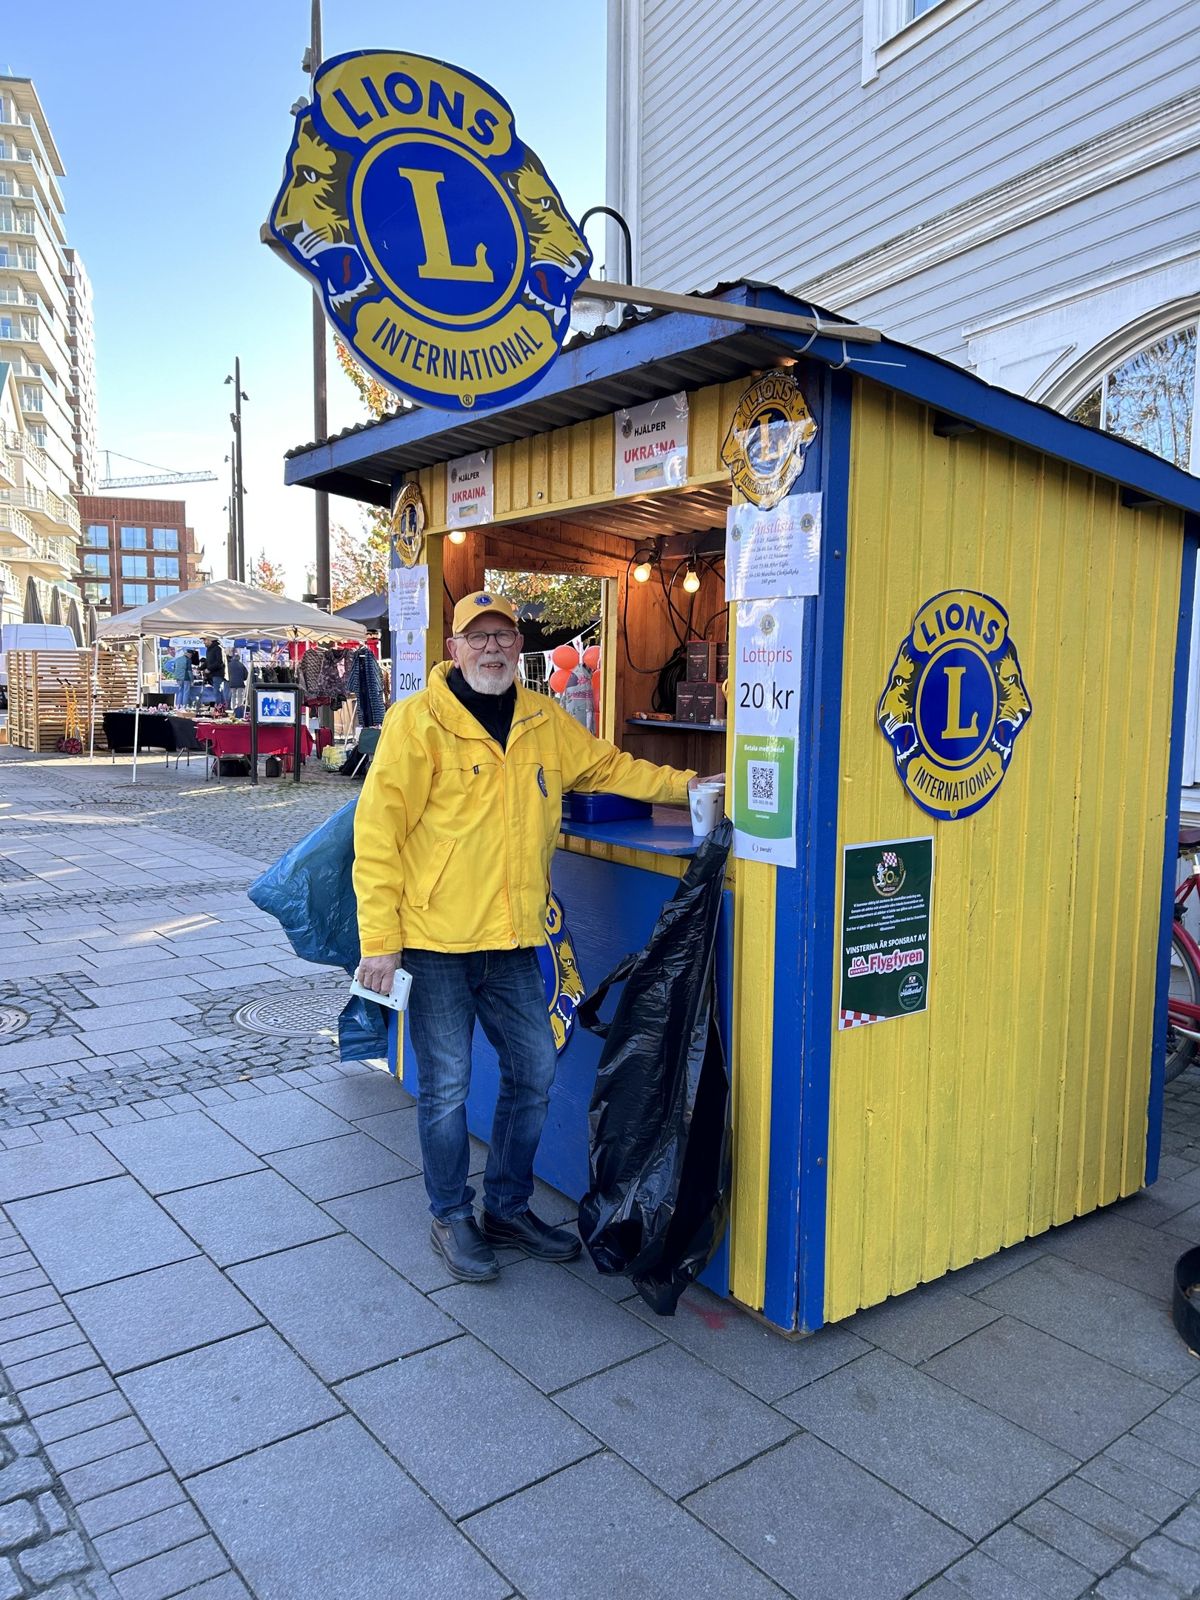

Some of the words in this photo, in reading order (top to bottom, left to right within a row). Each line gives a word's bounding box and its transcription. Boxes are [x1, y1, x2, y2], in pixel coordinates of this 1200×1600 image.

[333, 72, 499, 146] LIONS
[398, 167, 494, 282] L
[372, 325, 543, 381] INTERNATIONAL
[745, 380, 793, 413] LIONS
[634, 421, 666, 437] HJÄLPER
[624, 440, 676, 463] UKRAINA
[459, 471, 480, 482] HJÄLPER
[452, 485, 486, 503] UKRAINA
[920, 603, 999, 646] LIONS
[400, 649, 422, 662] Lottpris
[743, 645, 793, 666] Lottpris
[740, 682, 765, 709] 20
[772, 681, 795, 710] kr
[941, 667, 979, 739] L
[913, 762, 997, 802] INTERNATIONAL
[846, 942, 878, 955] VINSTERNA
[879, 938, 887, 949] ÄR
[888, 934, 918, 947] SPONSRAT
[918, 932, 927, 942] AV
[853, 958, 866, 968] ICA
[869, 949, 923, 972] Flygfyren
